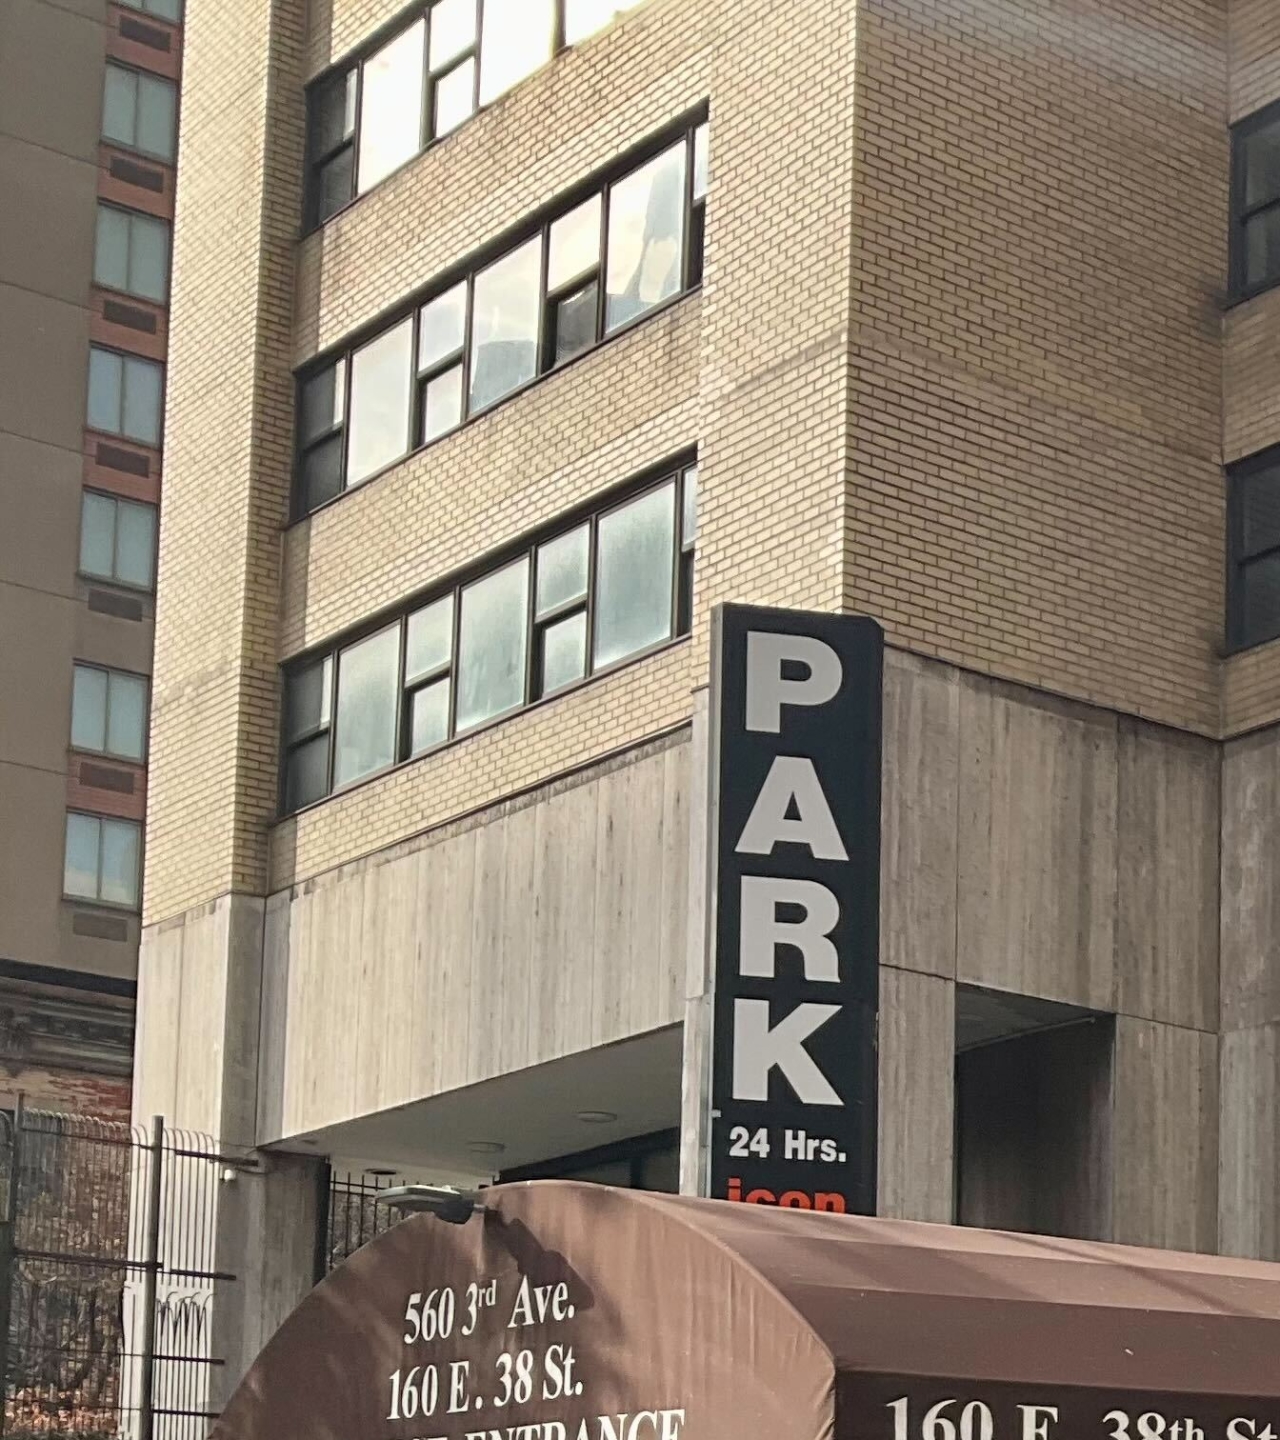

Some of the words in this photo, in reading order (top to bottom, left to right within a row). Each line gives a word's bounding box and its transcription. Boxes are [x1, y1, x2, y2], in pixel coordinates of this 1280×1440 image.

[732, 630, 849, 1107] PARK
[729, 1126, 770, 1159] 24
[785, 1130, 848, 1163] Hrs.
[403, 1286, 455, 1345] 560
[461, 1279, 496, 1337] 3rd
[508, 1274, 575, 1330] Ave.
[387, 1366, 438, 1421] 160
[494, 1349, 533, 1407] 38
[543, 1345, 583, 1401] St.
